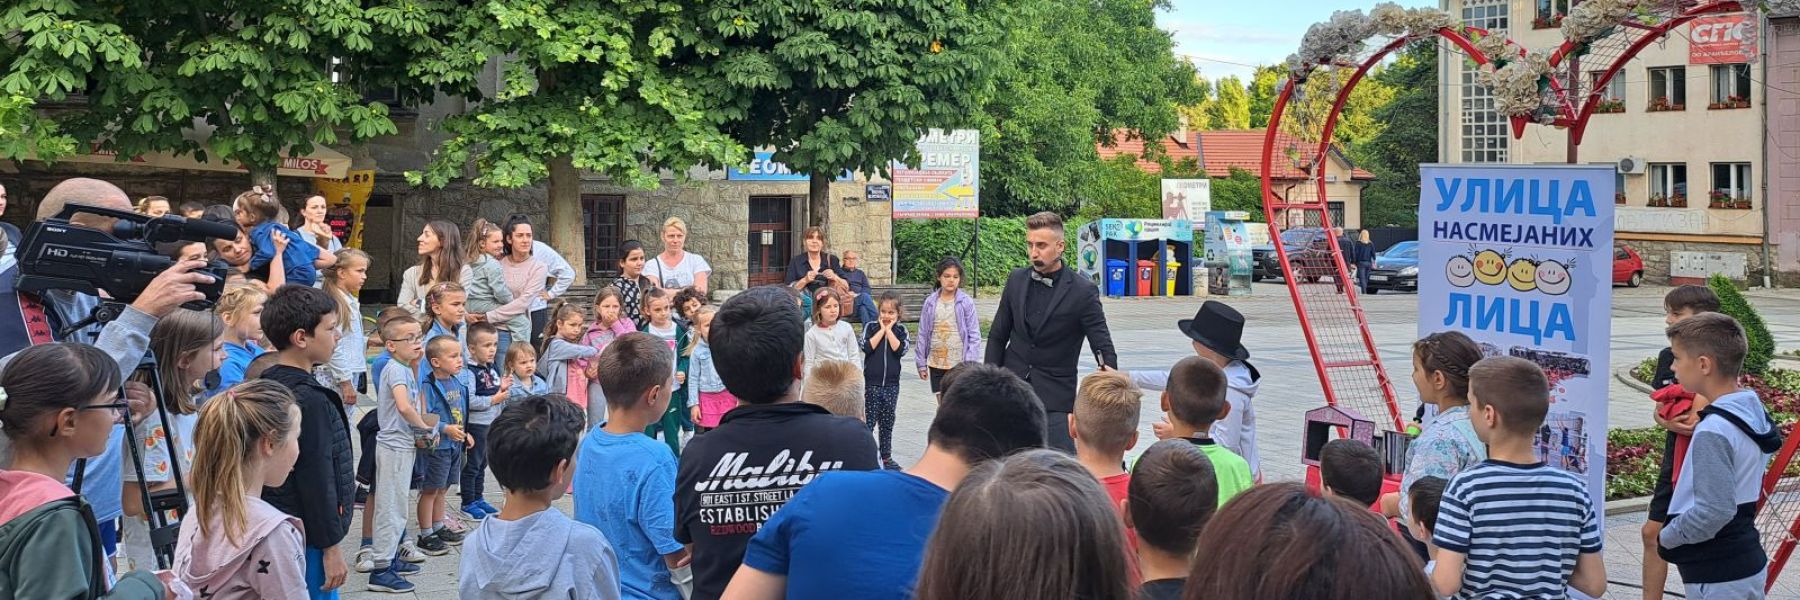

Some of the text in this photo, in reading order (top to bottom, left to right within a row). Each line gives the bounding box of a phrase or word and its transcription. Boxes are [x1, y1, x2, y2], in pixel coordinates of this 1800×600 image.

[1691, 21, 1755, 44] СПС
[283, 158, 318, 170] MILOS
[920, 152, 972, 168] ЕМЕР
[1434, 177, 1596, 224] УЛИЦА
[1433, 220, 1594, 248] НАСМЕЈАНИХ
[47, 248, 68, 258] HD
[1443, 292, 1576, 346] ЛИЦА
[714, 494, 733, 504] EAST
[753, 491, 782, 501] STREET
[699, 505, 785, 524] ESTABLISH
